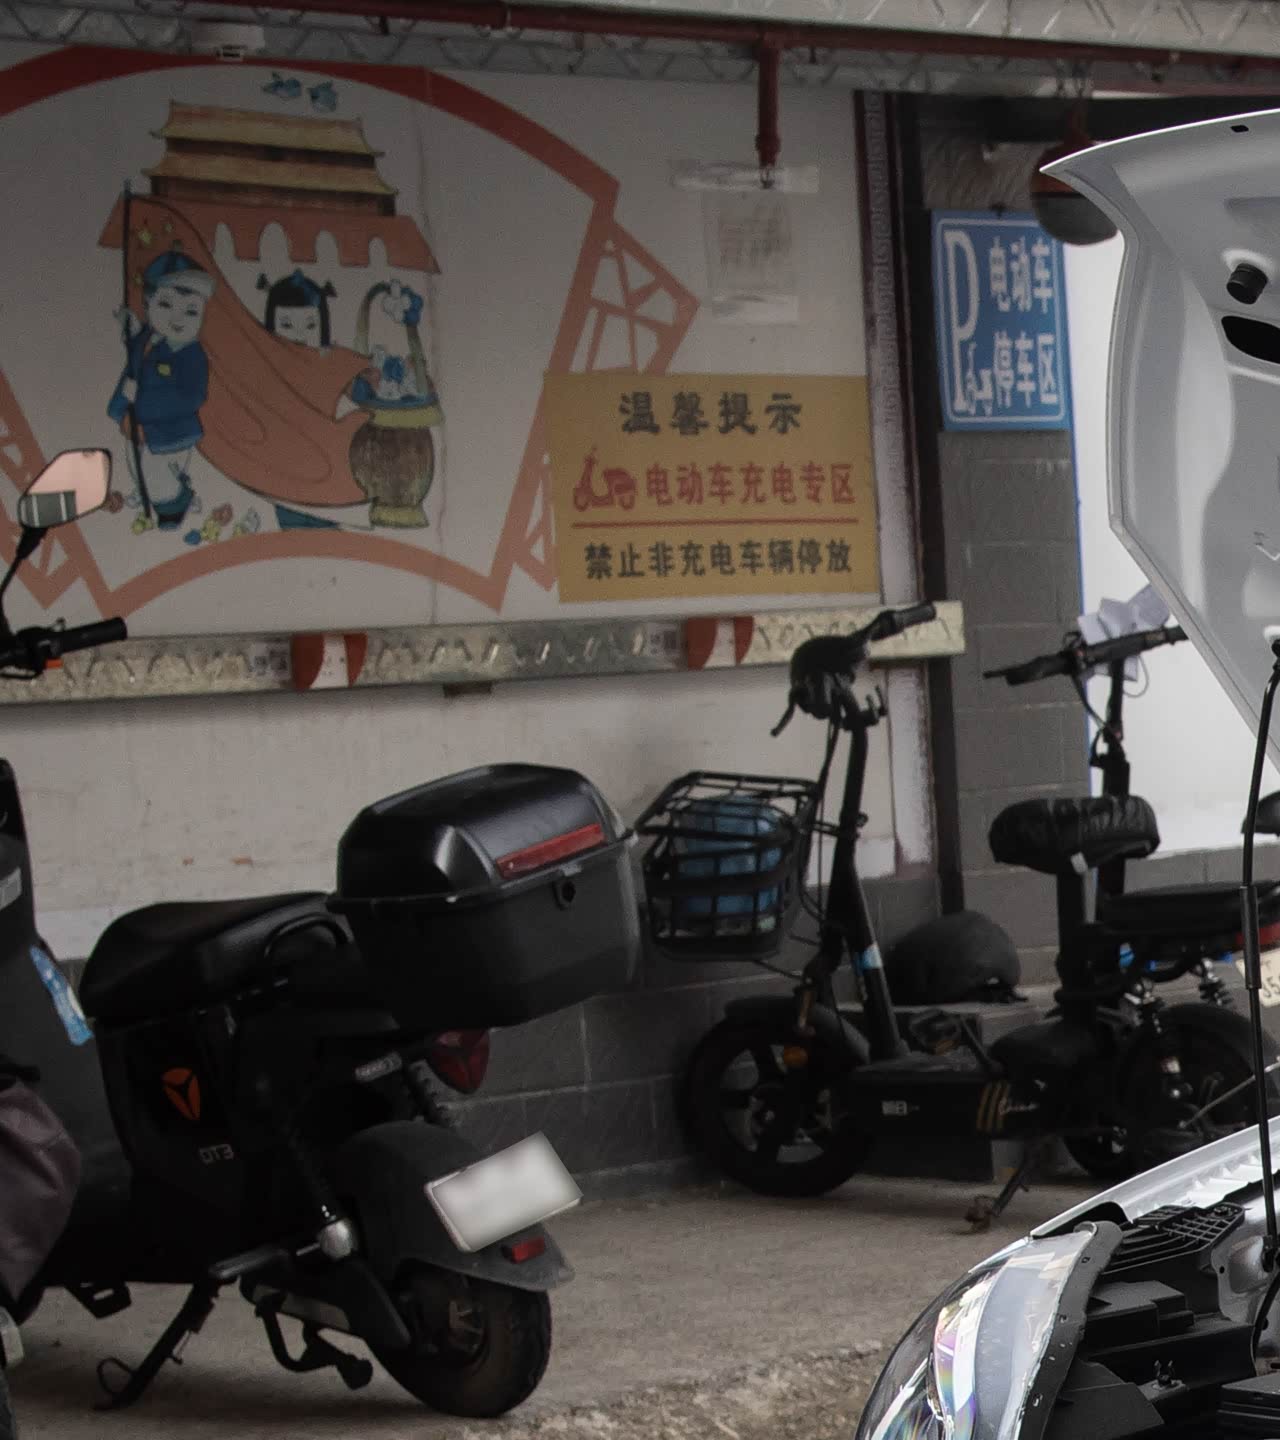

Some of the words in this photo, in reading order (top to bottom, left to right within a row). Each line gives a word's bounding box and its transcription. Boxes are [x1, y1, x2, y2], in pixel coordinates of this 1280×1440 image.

[944, 230, 980, 412] P
[993, 330, 1058, 409] 停车区
[618, 390, 803, 436] 温馨提示
[645, 459, 857, 507] 电动车充电专区
[584, 537, 853, 582] 禁止非充电车辆停放
